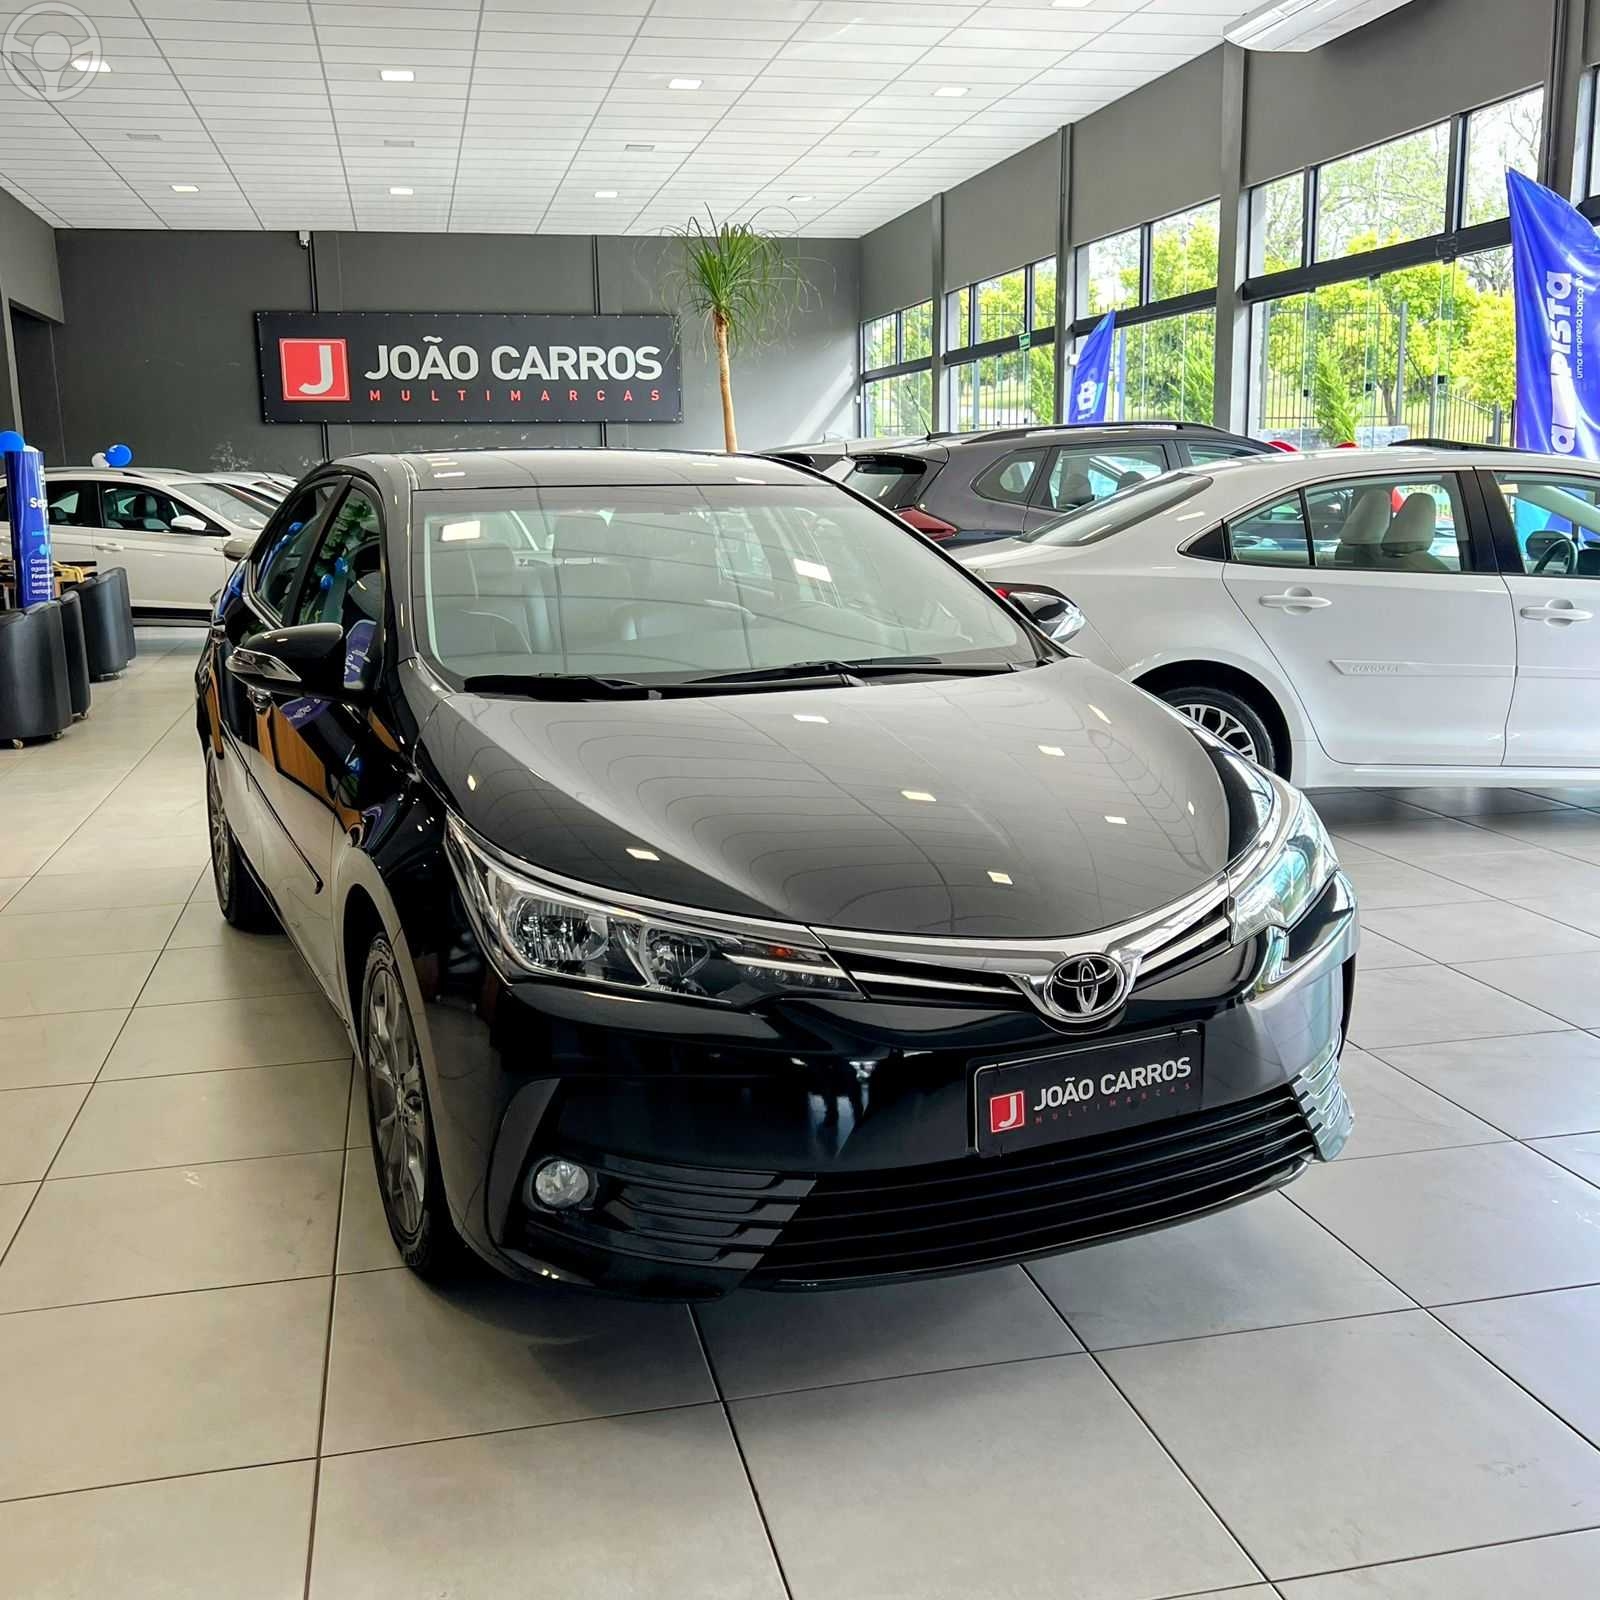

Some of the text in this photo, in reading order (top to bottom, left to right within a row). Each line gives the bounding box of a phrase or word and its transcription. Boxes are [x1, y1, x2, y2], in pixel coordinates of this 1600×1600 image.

[364, 335, 663, 382] JOÃO CARROS
[1575, 319, 1584, 357] empresa
[298, 345, 334, 395] J
[369, 389, 661, 402] MULTIMARCAS
[1033, 1056, 1192, 1112] JOÃO CARROS
[1035, 1083, 1191, 1124] MULTIMARCAS
